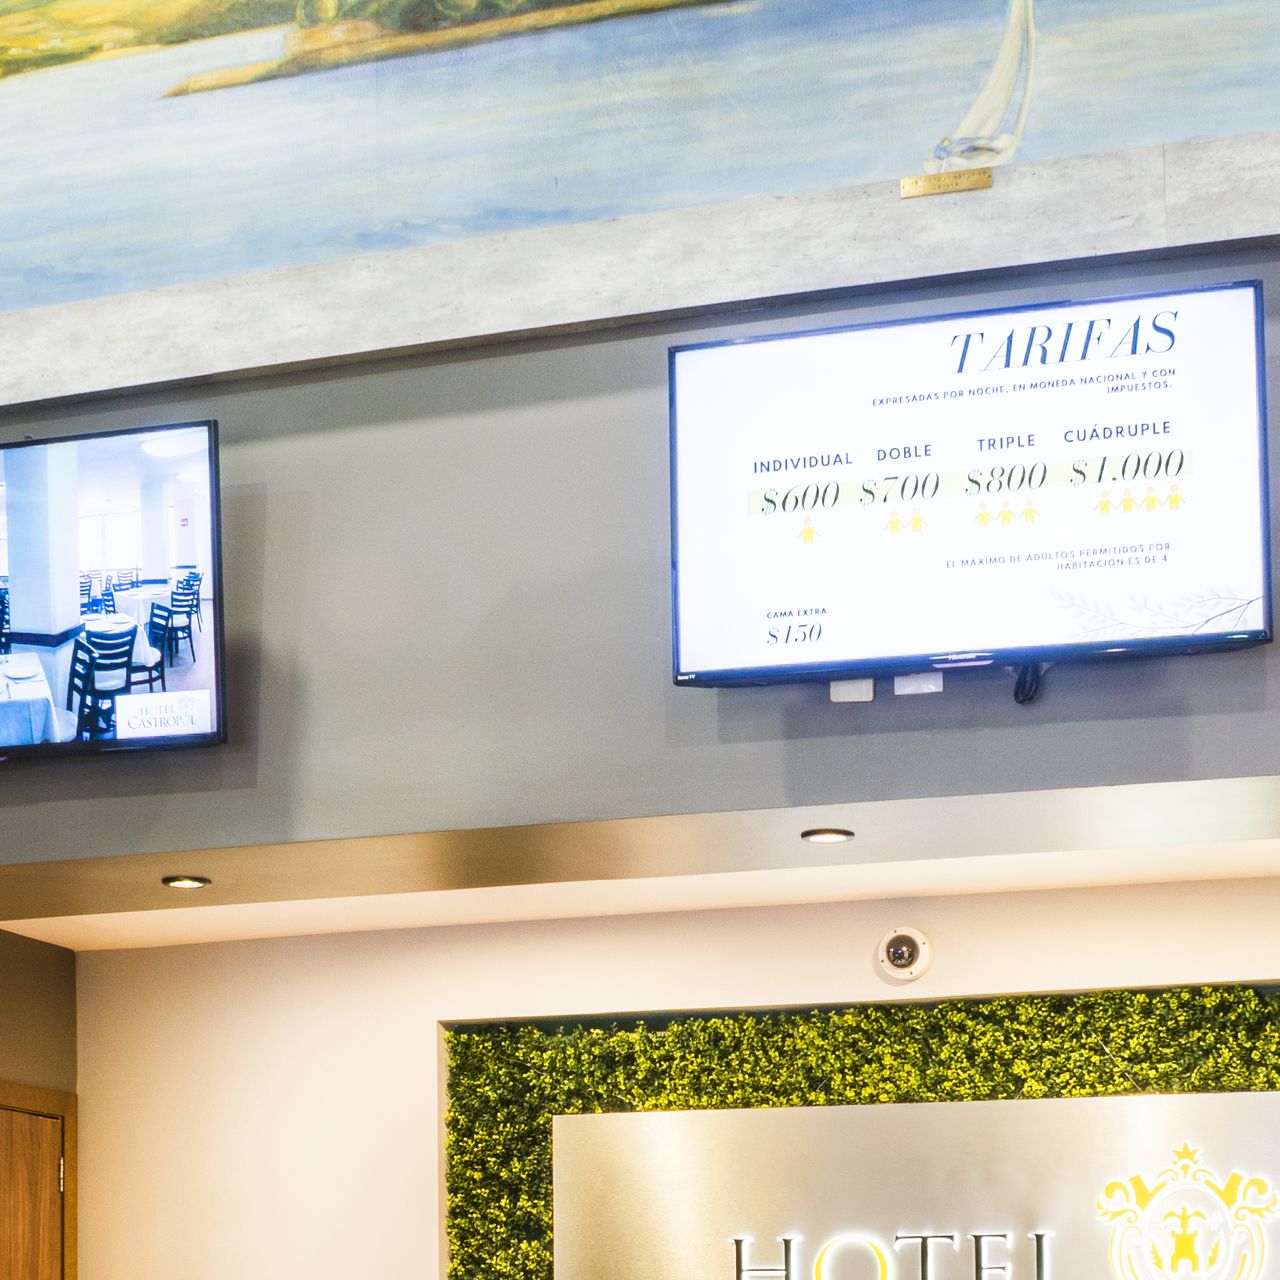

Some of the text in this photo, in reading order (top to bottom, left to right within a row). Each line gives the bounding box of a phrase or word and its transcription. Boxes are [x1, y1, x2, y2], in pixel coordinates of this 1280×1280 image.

[950, 310, 1179, 374] TARIFAS
[872, 368, 1176, 407] EXPRESADAS POR NOCHE, EN MONEDA NACIONAL Y CON
[1107, 381, 1172, 394] IMPUESTOS.
[753, 420, 1172, 474] INDIVIDUAL DOBLE TRIPLE CUÁDRUPLE
[761, 448, 1186, 517] $600 $700 $800 $1.000
[946, 561, 956, 569] EL
[1010, 555, 1022, 563] DE
[1026, 550, 1075, 562] ADULTOS
[1079, 544, 1145, 557] PERMITIDOS
[1148, 542, 1171, 552] POR
[1128, 557, 1140, 565] ES
[1144, 555, 1157, 564] DE
[1161, 554, 1168, 563] 4
[766, 608, 827, 619] CAMA EXTRA
[766, 622, 823, 646] $150
[140, 704, 177, 716] HTEL
